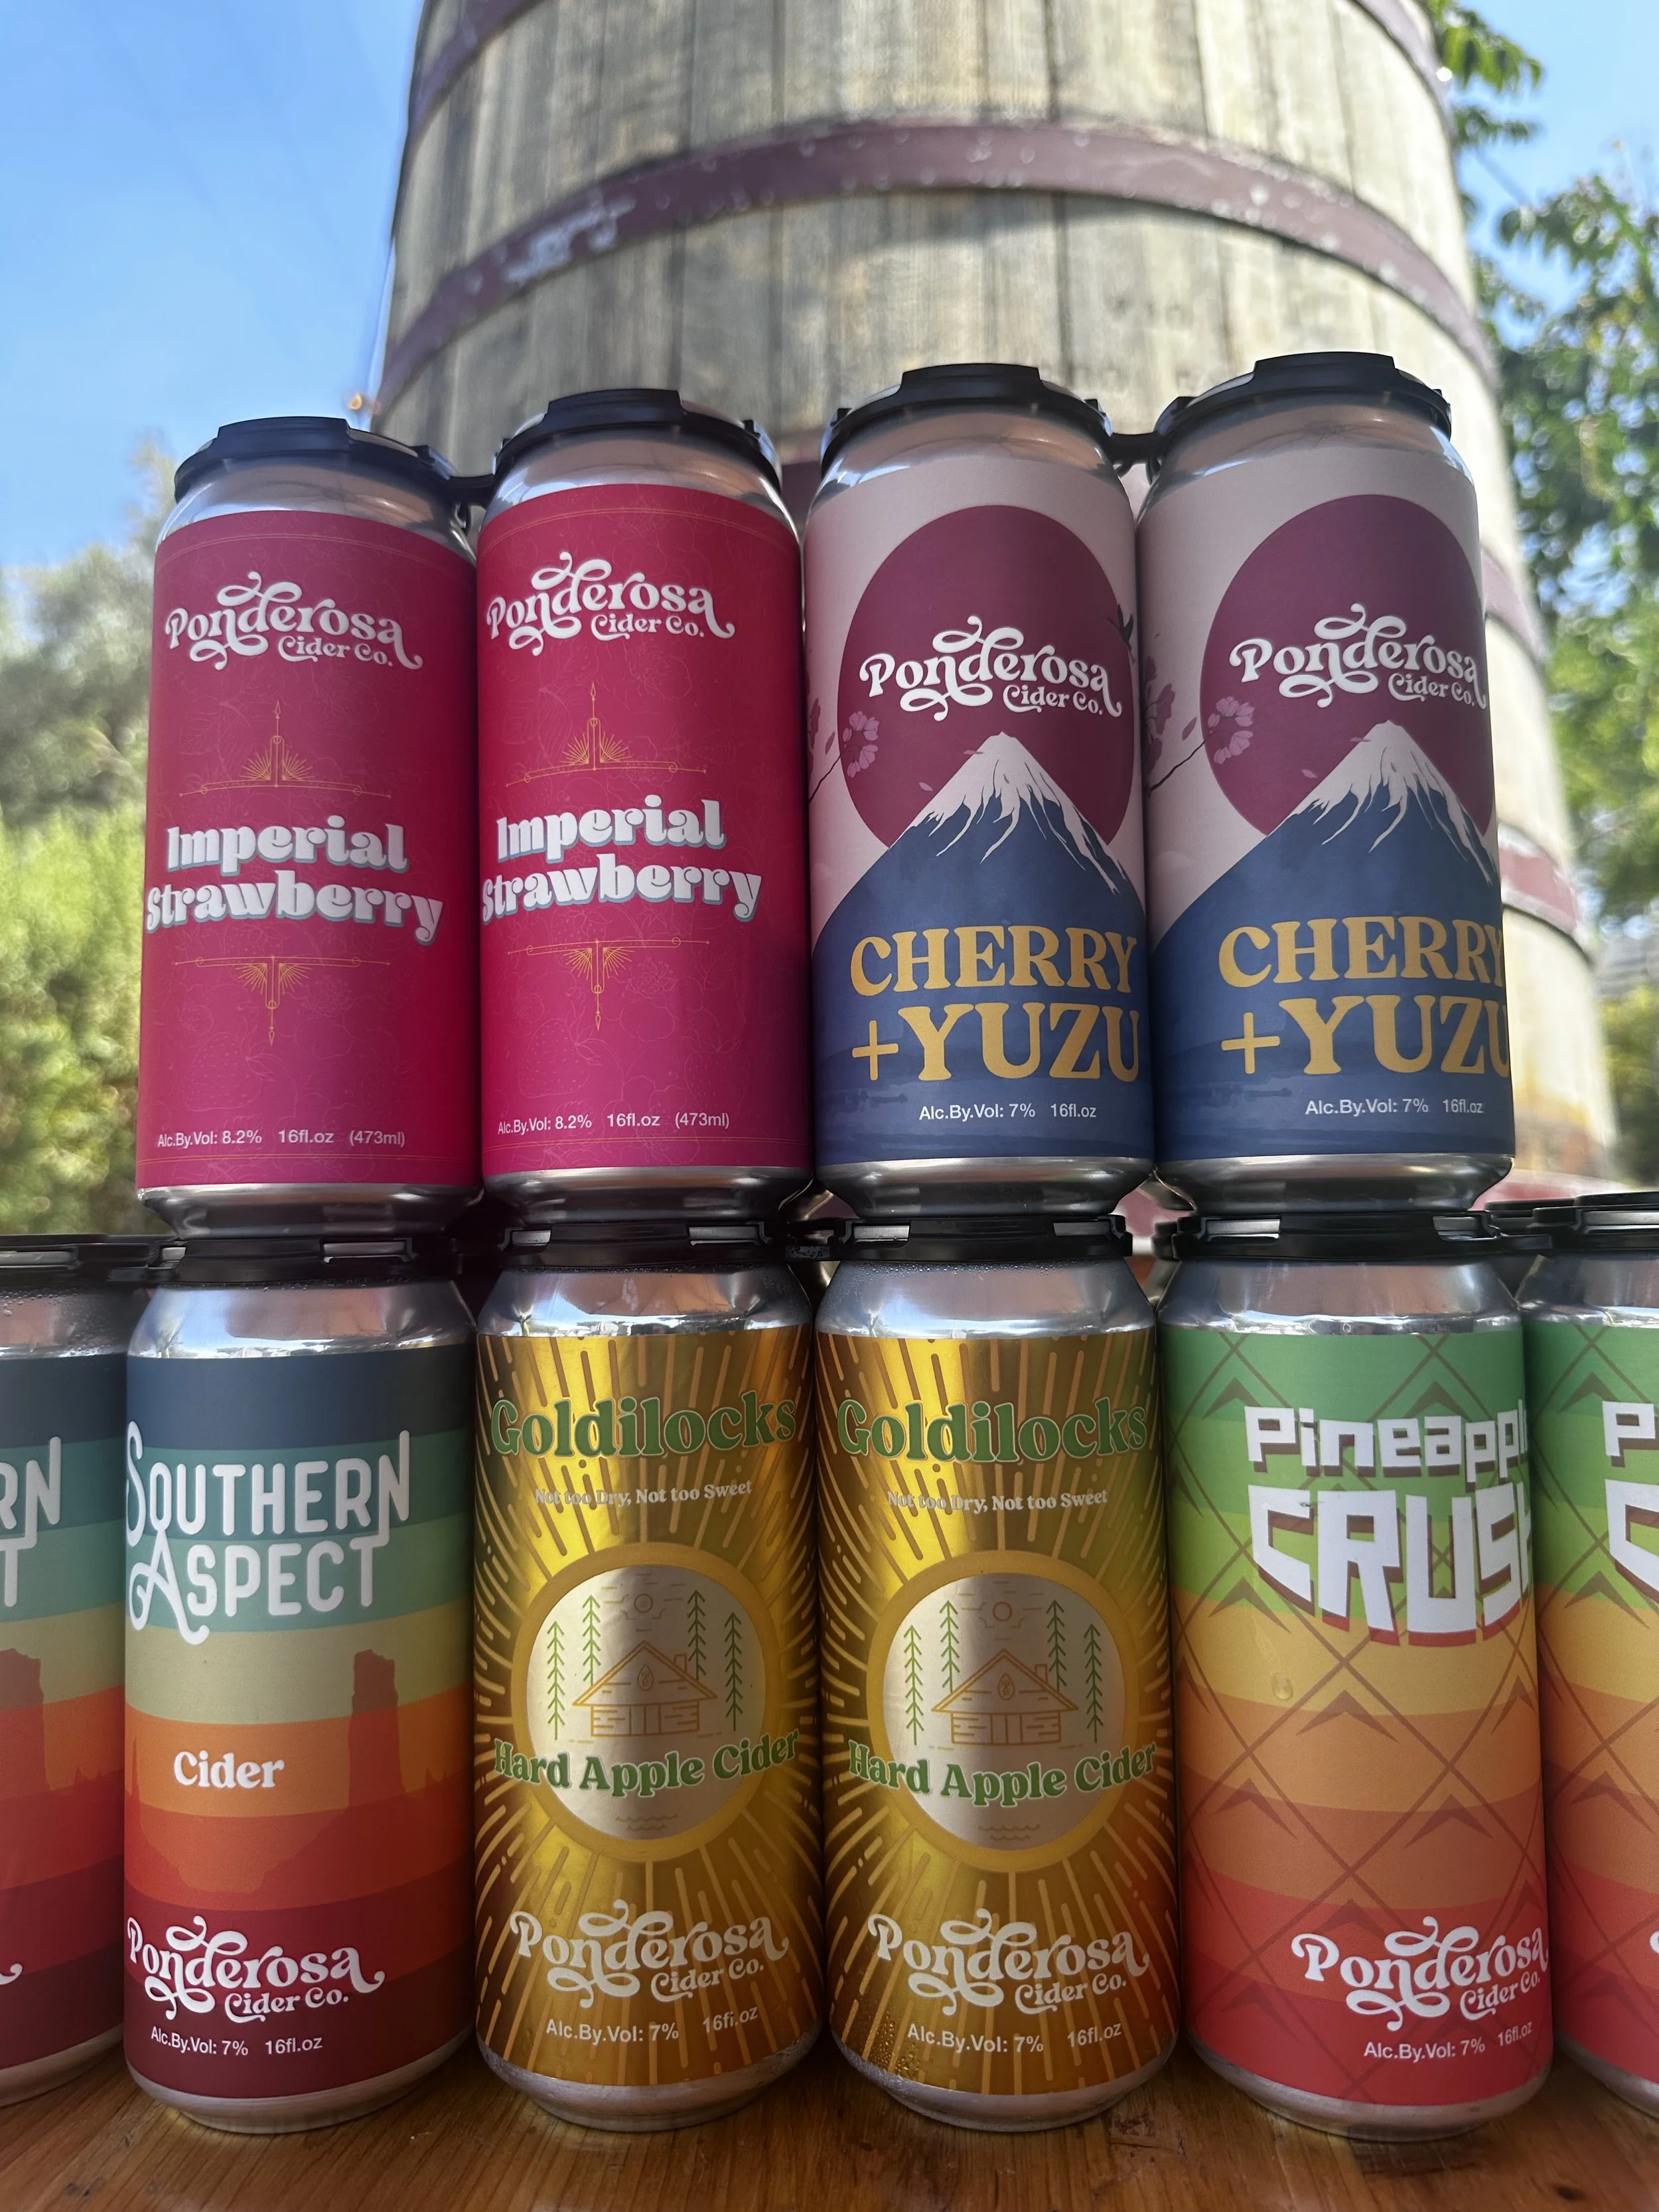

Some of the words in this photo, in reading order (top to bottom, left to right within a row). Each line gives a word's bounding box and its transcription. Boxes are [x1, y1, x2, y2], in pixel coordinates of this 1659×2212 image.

[165, 571, 423, 670] Ponderosa
[486, 552, 735, 656] Ponderosa
[591, 614, 662, 641] Cider
[666, 616, 705, 637] Co.
[277, 636, 350, 663] Cider
[354, 643, 393, 666] Co.
[859, 615, 1121, 721] Ponderosa
[1229, 603, 1486, 707] Ponderosa
[1003, 685, 1069, 713] Cider
[1072, 692, 1103, 715] Co.
[1388, 673, 1449, 702] Cider
[1451, 682, 1475, 707] Co.
[167, 815, 409, 876] Imperial
[496, 794, 727, 863] Imperial
[851, 925, 1137, 996] CHERRY
[555, 1114, 593, 1130] 8.2%
[674, 1112, 730, 1130] (473ml)
[1009, 1103, 1036, 1118] 7%
[1402, 1098, 1429, 1113] 7%
[222, 1130, 263, 1144] 8.2%
[349, 1130, 405, 1147] (473ml)
[491, 1390, 796, 1458] Goldilocks
[837, 1396, 1147, 1463] Goldilocks
[126, 1420, 410, 1547] SOUTHERN
[536, 1489, 561, 1505] Not
[564, 1491, 593, 1505] too
[597, 1491, 631, 1507] Dry,
[636, 1489, 667, 1504] Not
[670, 1486, 700, 1501] too
[703, 1479, 753, 1499] Sweet
[887, 1491, 914, 1507] Not
[918, 1494, 946, 1509] too
[951, 1495, 987, 1513] Dry,
[992, 1494, 1024, 1511] Not
[1027, 1494, 1057, 1509] too
[1061, 1488, 1109, 1508] Sweet
[129, 1529, 387, 1645] ASPECT
[173, 1750, 285, 1789] Cider
[494, 1738, 571, 1789] Hard
[579, 1750, 705, 1798] Apple
[712, 1728, 799, 1781] Cider
[848, 1739, 931, 1795] Hard
[940, 1761, 1066, 1808] Apple
[1074, 1741, 1156, 1791] Cider
[127, 1915, 386, 2020] Ponderosa
[510, 1899, 790, 2009] Ponderosa
[867, 1908, 1150, 2016] Ponderosa
[1291, 1915, 1549, 2031] Ponderosa
[650, 1968, 725, 2003] Cider
[729, 1957, 764, 1980] Co.
[1015, 1980, 1088, 2015] Cider
[1092, 1972, 1127, 1995] Co.
[1460, 1983, 1519, 2021] Cider
[1520, 1970, 1541, 1994] Co.
[224, 1992, 301, 2023] Cider
[305, 1987, 349, 2008] Co.
[222, 2039, 249, 2056] 7%
[650, 2023, 679, 2041] 7%
[1014, 2035, 1045, 2053] 7%
[1461, 2039, 1486, 2056] 7%
